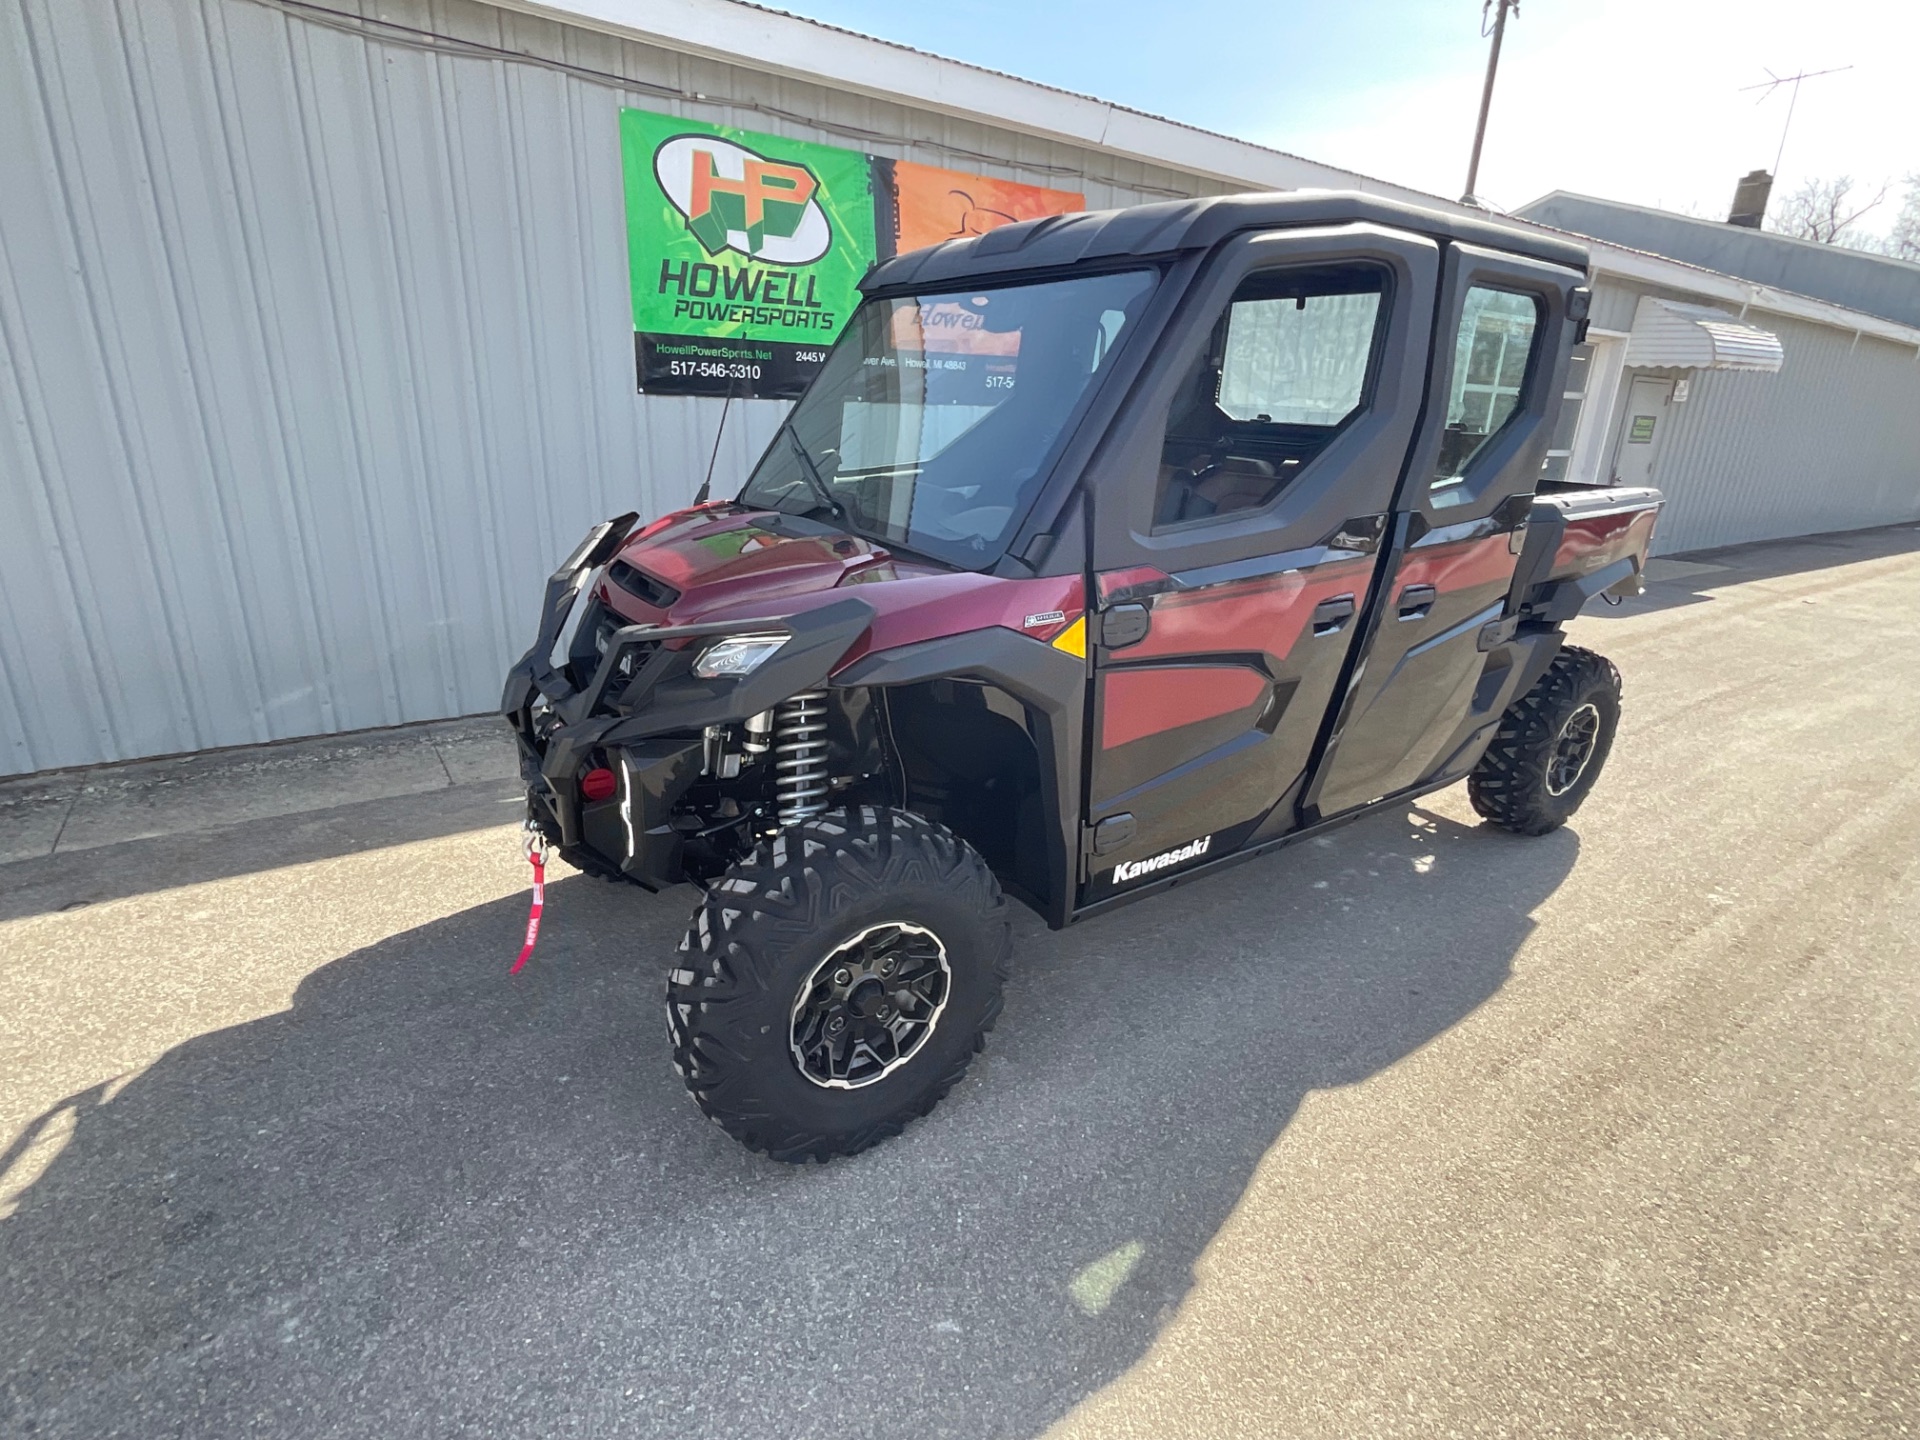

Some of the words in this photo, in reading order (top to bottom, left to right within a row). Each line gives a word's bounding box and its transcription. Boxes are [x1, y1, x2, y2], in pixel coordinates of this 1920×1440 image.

[689, 149, 817, 230] HP
[658, 258, 822, 308] HOWELL
[674, 299, 835, 330] POWERSPORTS
[656, 343, 772, 360] HowellPowerSports.Net
[795, 351, 818, 363] 2445
[880, 356, 897, 367] Ave.
[670, 360, 761, 380] 517-546-3310
[1112, 835, 1211, 884] Kawasaki
